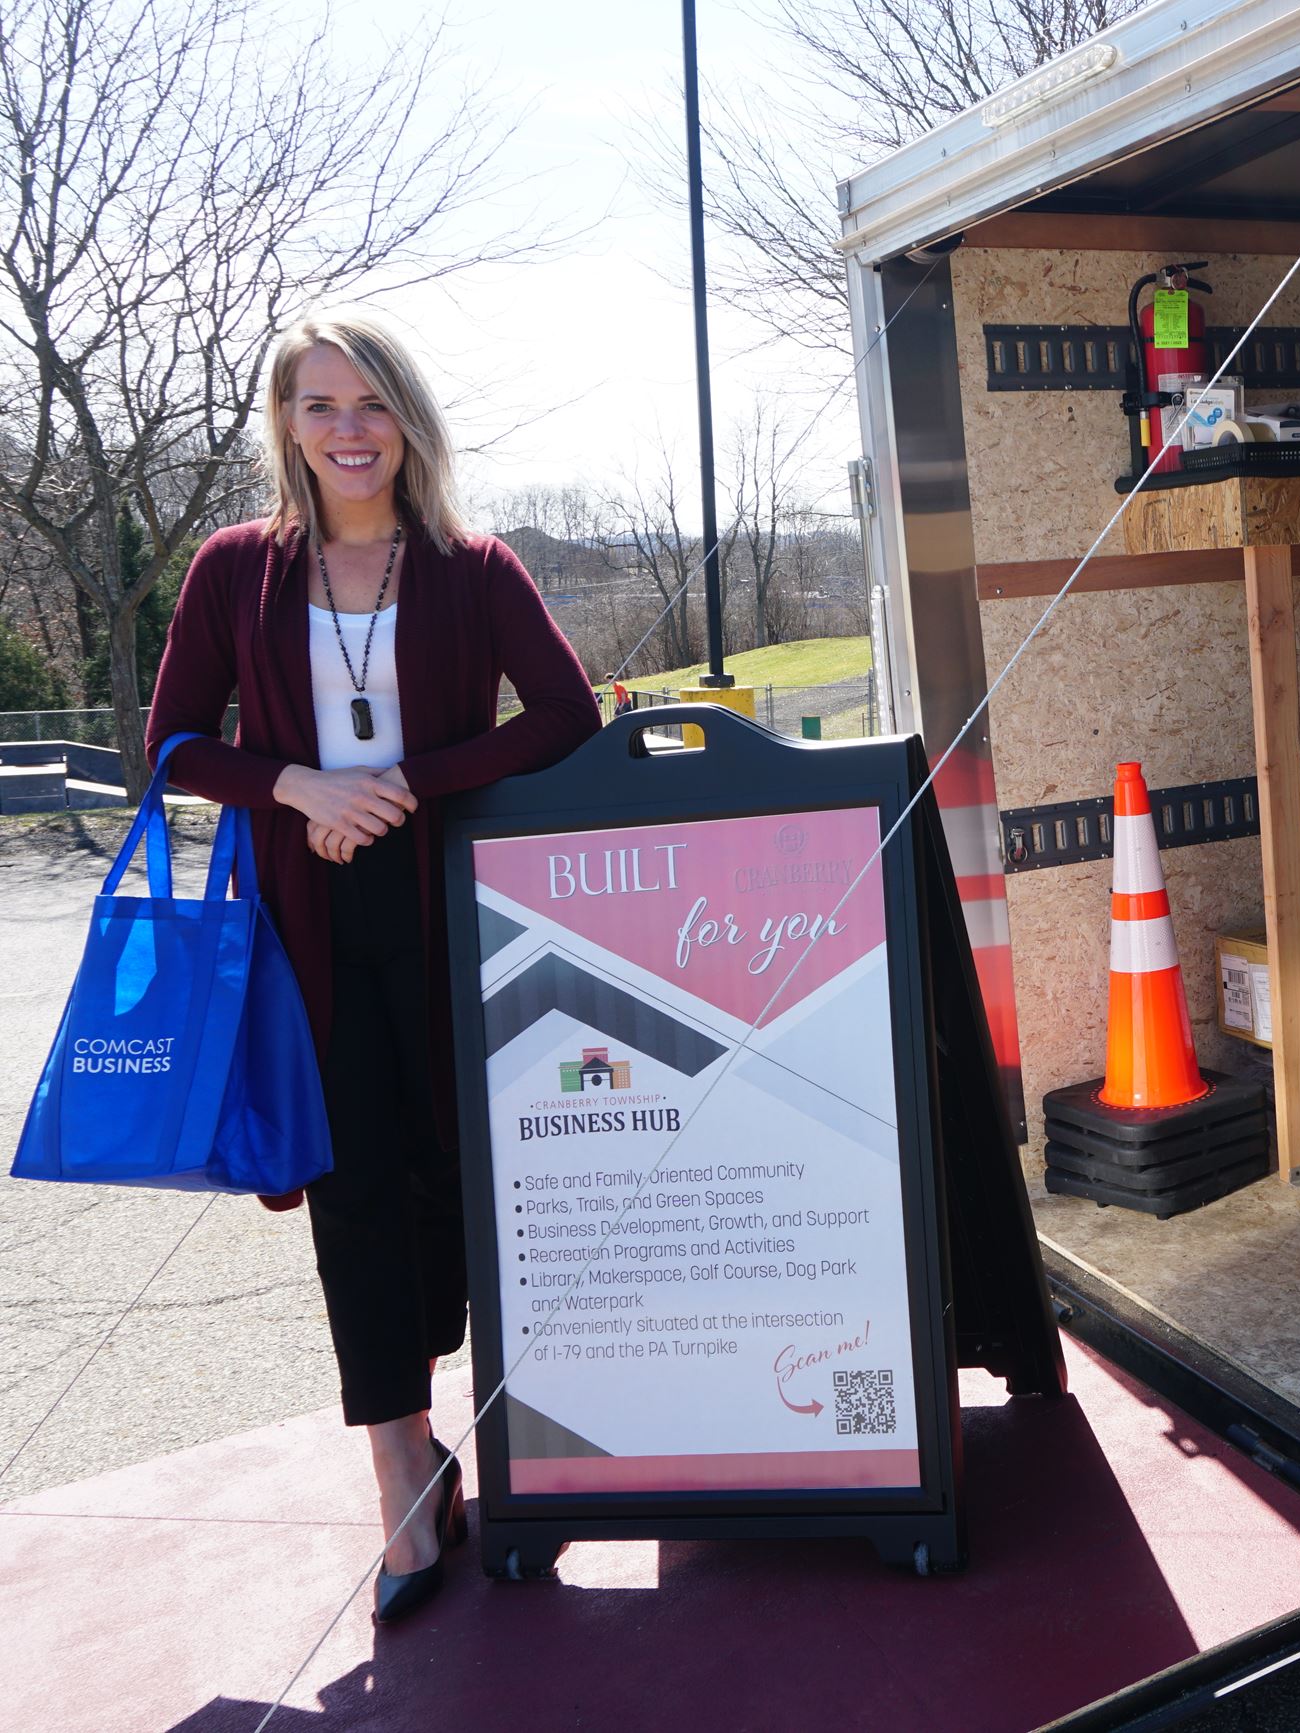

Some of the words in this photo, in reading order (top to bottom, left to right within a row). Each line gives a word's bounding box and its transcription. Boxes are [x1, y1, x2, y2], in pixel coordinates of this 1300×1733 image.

[547, 843, 688, 900] BUILT
[733, 857, 855, 894] CRANBERRY
[676, 896, 748, 969] for
[748, 912, 848, 975] you
[73, 1037, 175, 1056] COMCAST
[72, 1056, 171, 1075] BUSINESS
[535, 1097, 599, 1111] CRANBERRY
[603, 1094, 661, 1106] TOWNSHIP
[519, 1111, 626, 1142] BUSINESS
[631, 1108, 681, 1132] HUB
[525, 1174, 559, 1191] Safe
[562, 1172, 592, 1189] and
[717, 1161, 805, 1181] Community
[526, 1198, 573, 1215] Parks,
[575, 1195, 619, 1212] Trails,
[622, 1193, 652, 1209] and
[656, 1192, 701, 1208] Green
[704, 1190, 764, 1209] Spaces
[528, 1222, 597, 1239] Business
[601, 1218, 705, 1236] Development,
[708, 1213, 768, 1230] Growth,
[772, 1210, 802, 1228] and
[806, 1209, 870, 1229] Support
[529, 1245, 610, 1263] Recreation
[614, 1243, 687, 1263] Programs
[690, 1240, 720, 1256] and
[724, 1237, 795, 1255] Activities
[531, 1271, 585, 1289] Library,
[588, 1268, 686, 1285] Makerspace,
[690, 1264, 719, 1281] Golf
[723, 1262, 782, 1280] Course,
[786, 1261, 817, 1281] Dog
[820, 1258, 857, 1276] Park
[531, 1295, 561, 1313] and
[564, 1292, 645, 1313] Waterpark
[533, 1316, 632, 1337] Conveniently
[636, 1314, 698, 1333] situated
[702, 1315, 718, 1330] at
[722, 1312, 748, 1330] the
[751, 1310, 844, 1328] intersection
[534, 1344, 549, 1361] of
[553, 1344, 582, 1361] I-79
[585, 1342, 615, 1360] and
[619, 1342, 644, 1359] the
[648, 1340, 669, 1357] PA
[672, 1338, 738, 1359] Turnpike
[773, 1344, 833, 1384] Scan
[836, 1319, 871, 1356] me!
